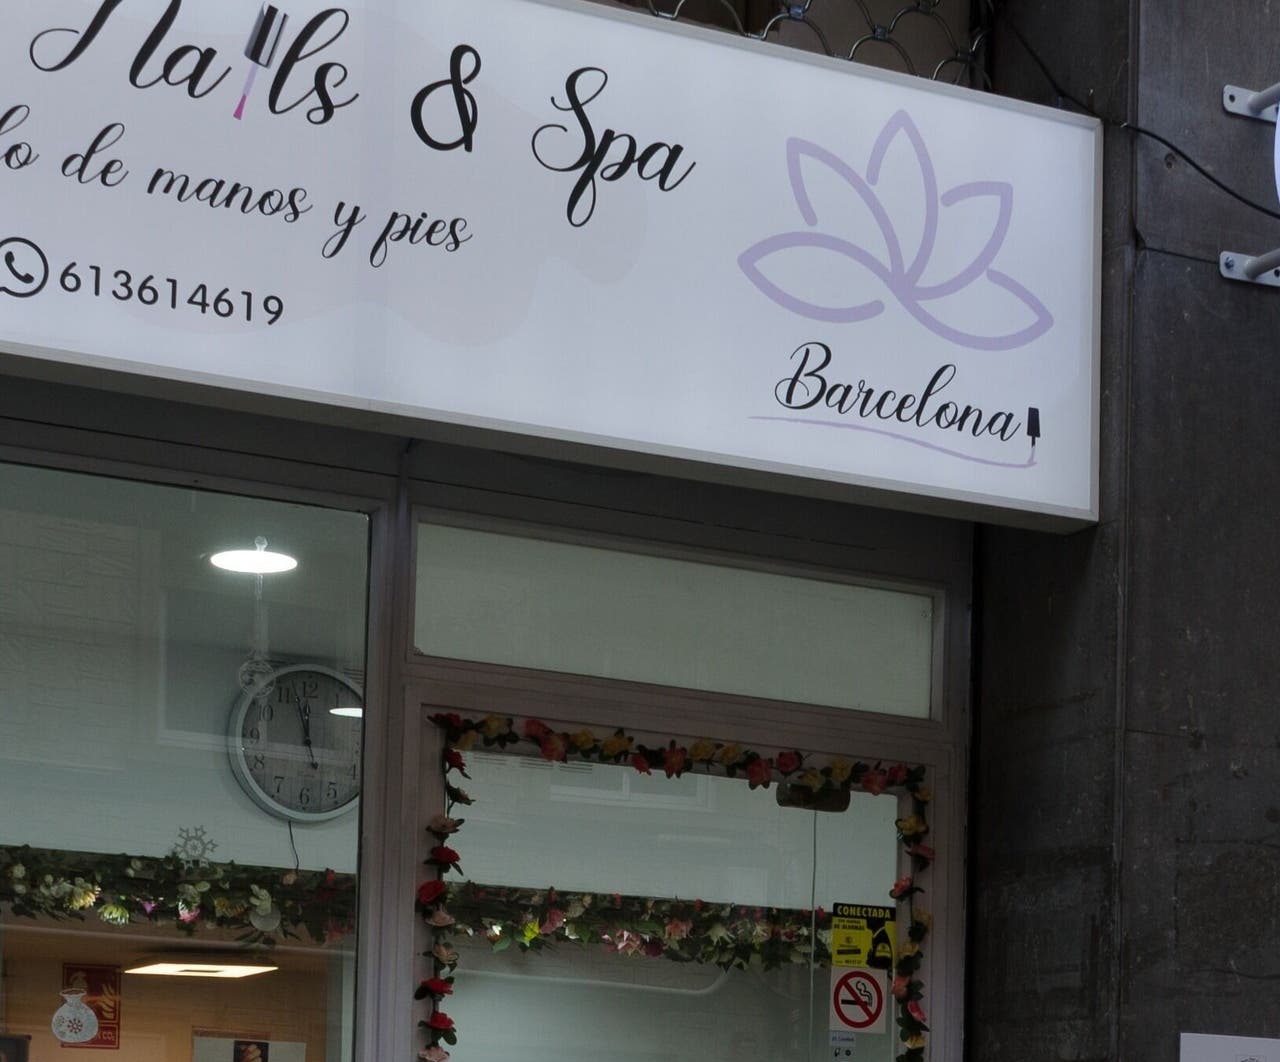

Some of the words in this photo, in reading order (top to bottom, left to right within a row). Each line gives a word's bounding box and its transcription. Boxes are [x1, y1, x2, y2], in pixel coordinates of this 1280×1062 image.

[410, 44, 482, 153] &
[531, 67, 697, 227] Spa
[61, 122, 129, 188] de
[147, 163, 313, 224] manos
[322, 199, 366, 258] y
[370, 205, 473, 268] pies
[59, 261, 284, 325] 613614619
[774, 342, 1022, 443] Barcelona
[837, 905, 891, 919] CONECTADA
